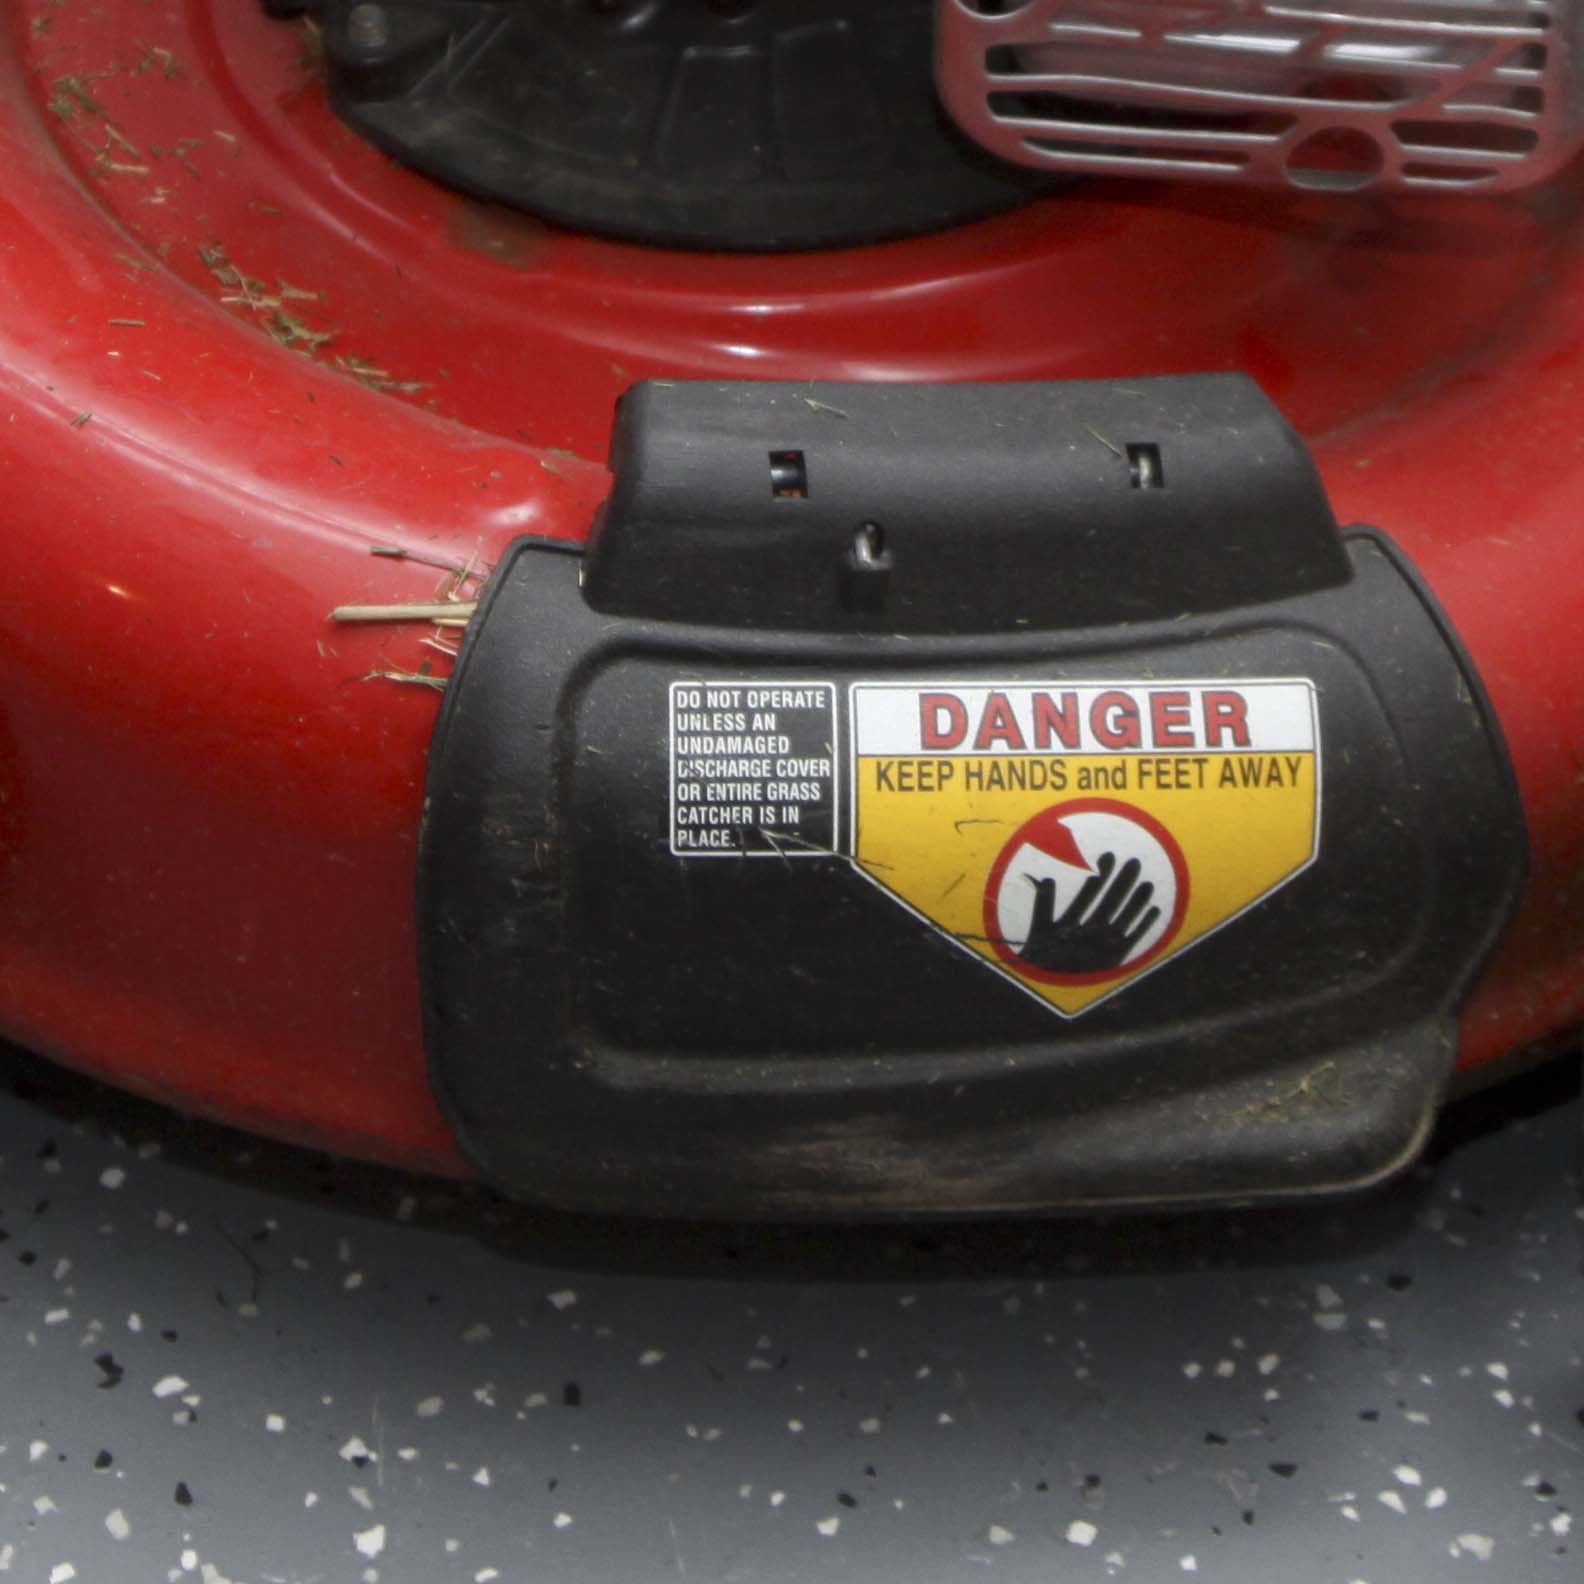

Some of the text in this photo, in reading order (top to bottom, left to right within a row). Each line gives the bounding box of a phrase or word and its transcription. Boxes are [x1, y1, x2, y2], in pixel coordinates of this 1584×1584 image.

[677, 691, 825, 708] DO NOT OPERATE
[677, 713, 776, 731] UNLESS AN
[919, 690, 1252, 751] DANGER
[677, 736, 790, 754] UNDAMAGED
[678, 759, 831, 778] DISCHARGE COVER
[876, 756, 1303, 792] KEEP HANDS and FEET AWAY
[677, 782, 821, 801] OR ENTIRE GRASS
[677, 806, 799, 824] CATCHER IS IN
[677, 829, 736, 847] PLACE.
